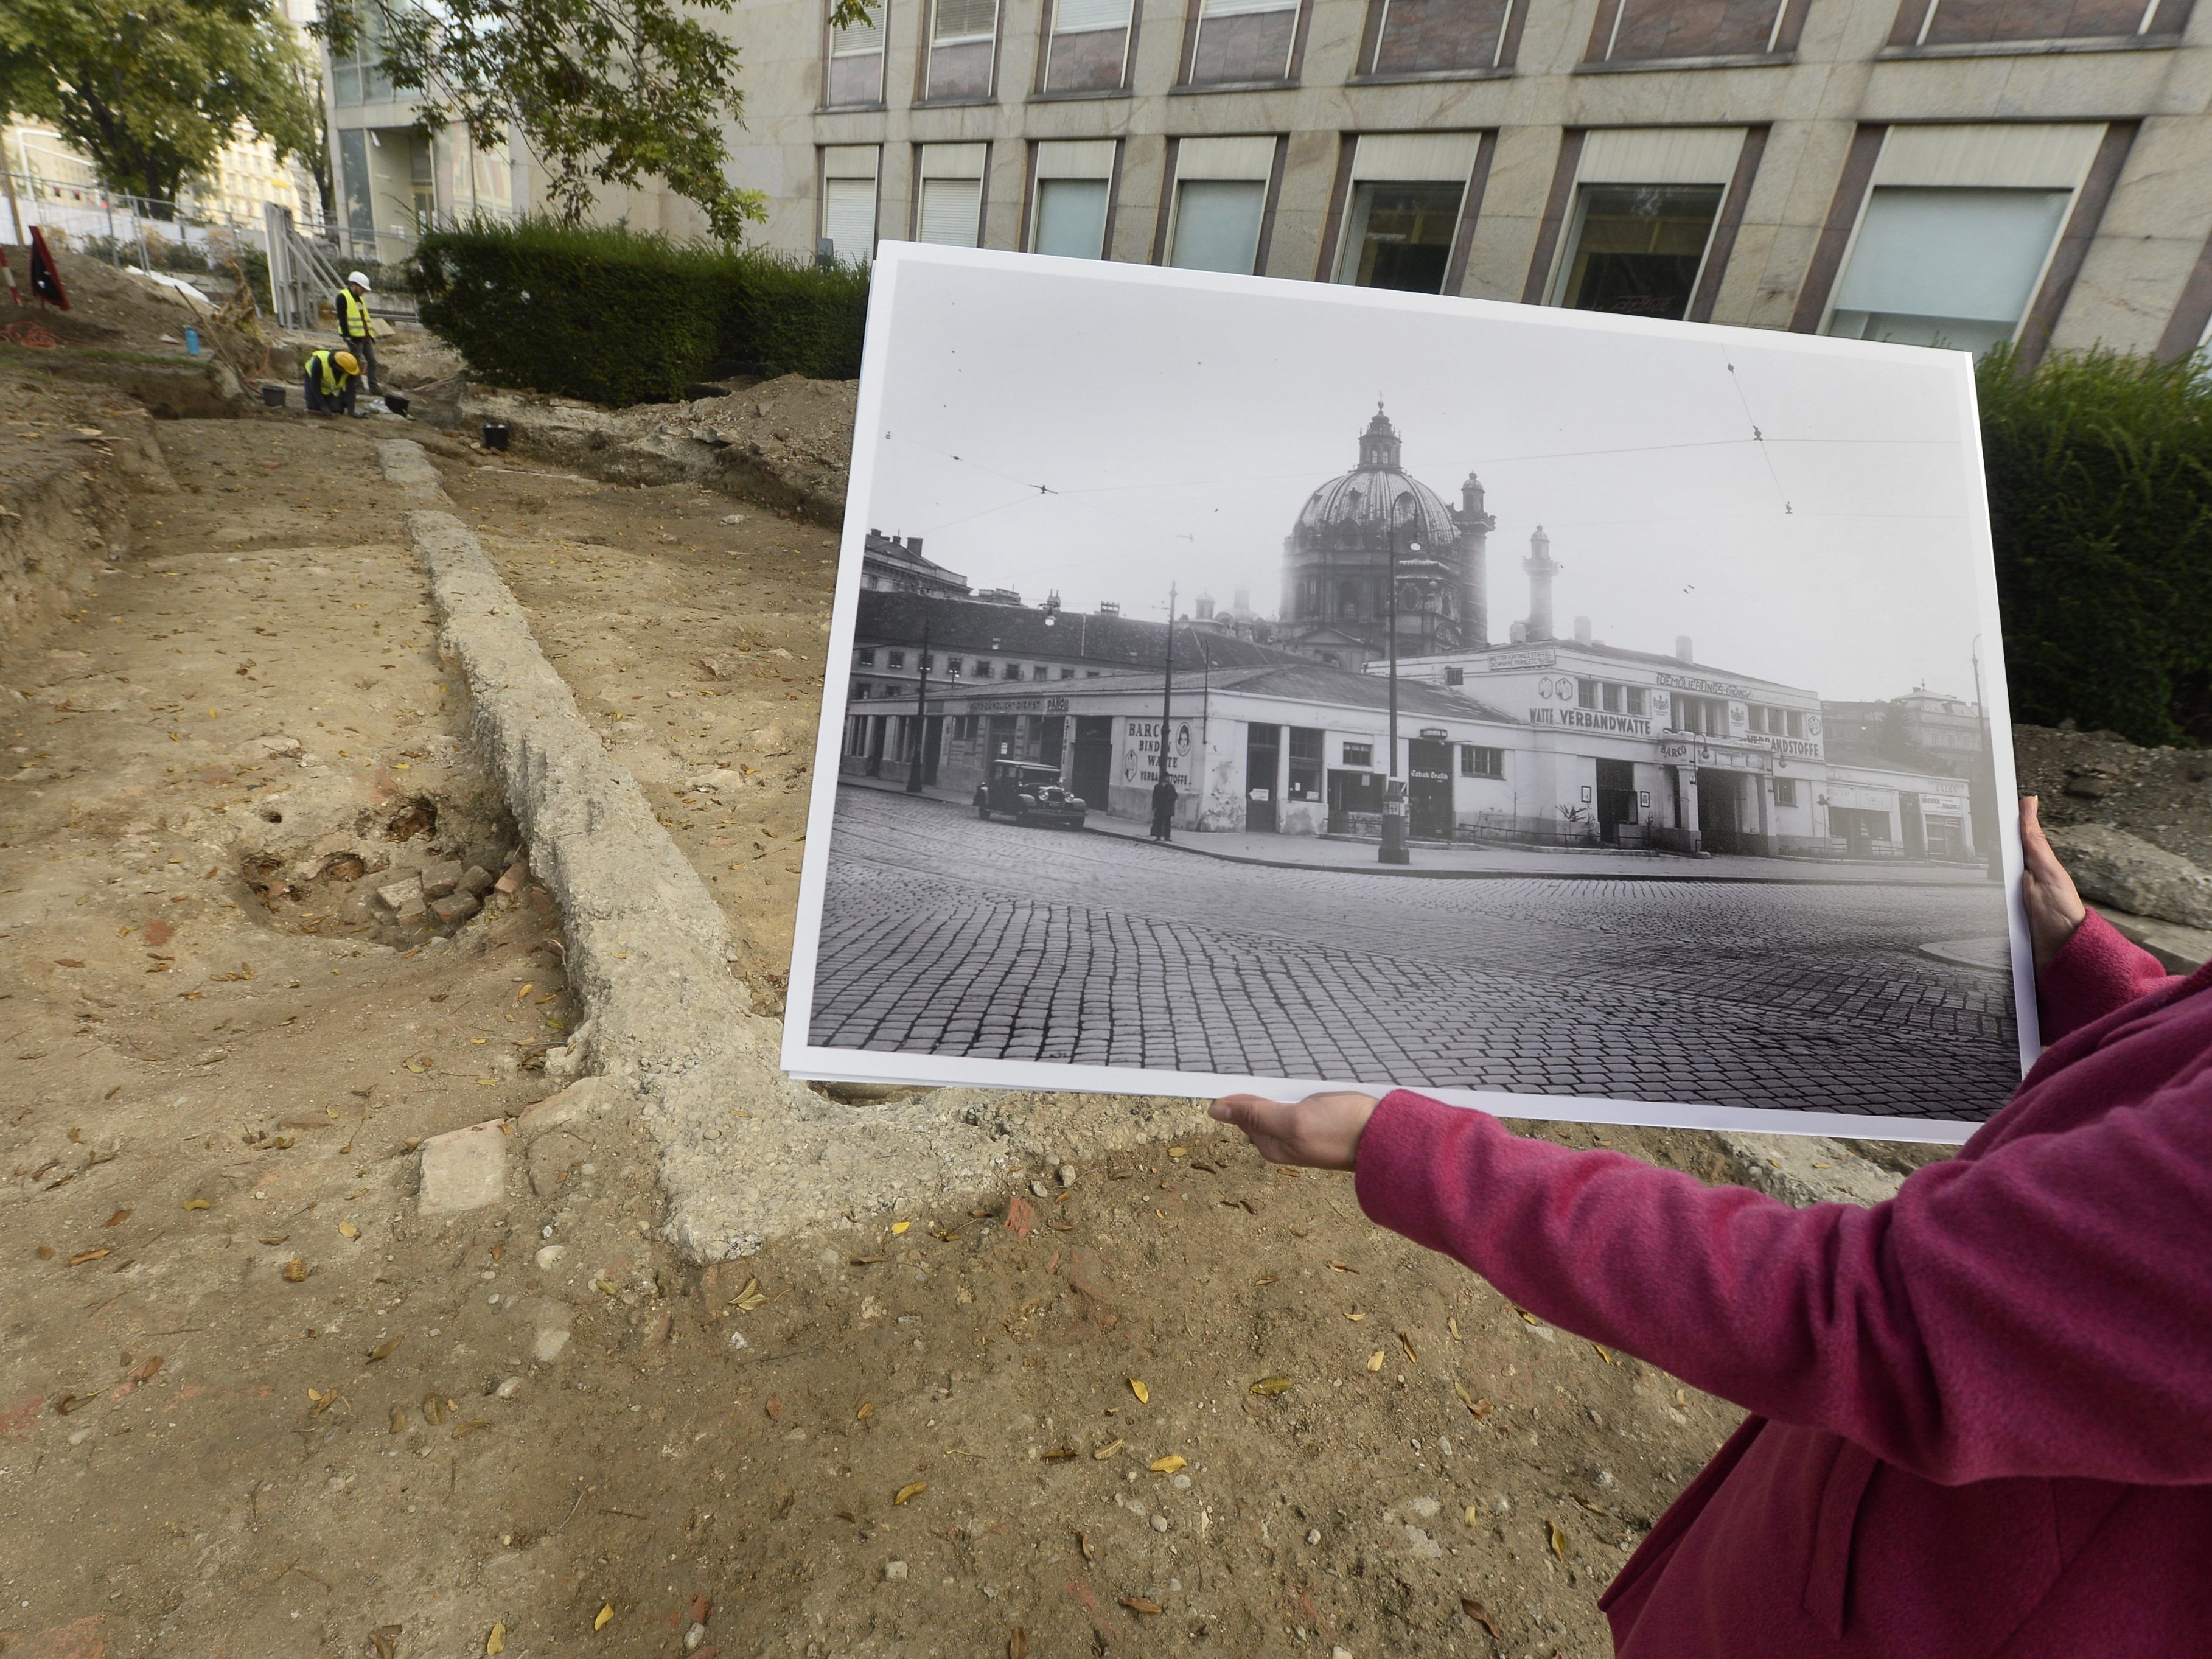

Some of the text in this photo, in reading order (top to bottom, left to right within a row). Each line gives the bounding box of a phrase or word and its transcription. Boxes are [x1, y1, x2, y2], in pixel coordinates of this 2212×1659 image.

[1529, 708, 1553, 724] WATTE
[1560, 709, 1651, 735] VERBANDWATTE
[1129, 723, 1162, 738] BARC
[1139, 740, 1171, 752] BIND
[1660, 744, 1686, 758] BARCO
[1148, 755, 1178, 768] WATE
[1140, 771, 1188, 785] VERBATOFFE
